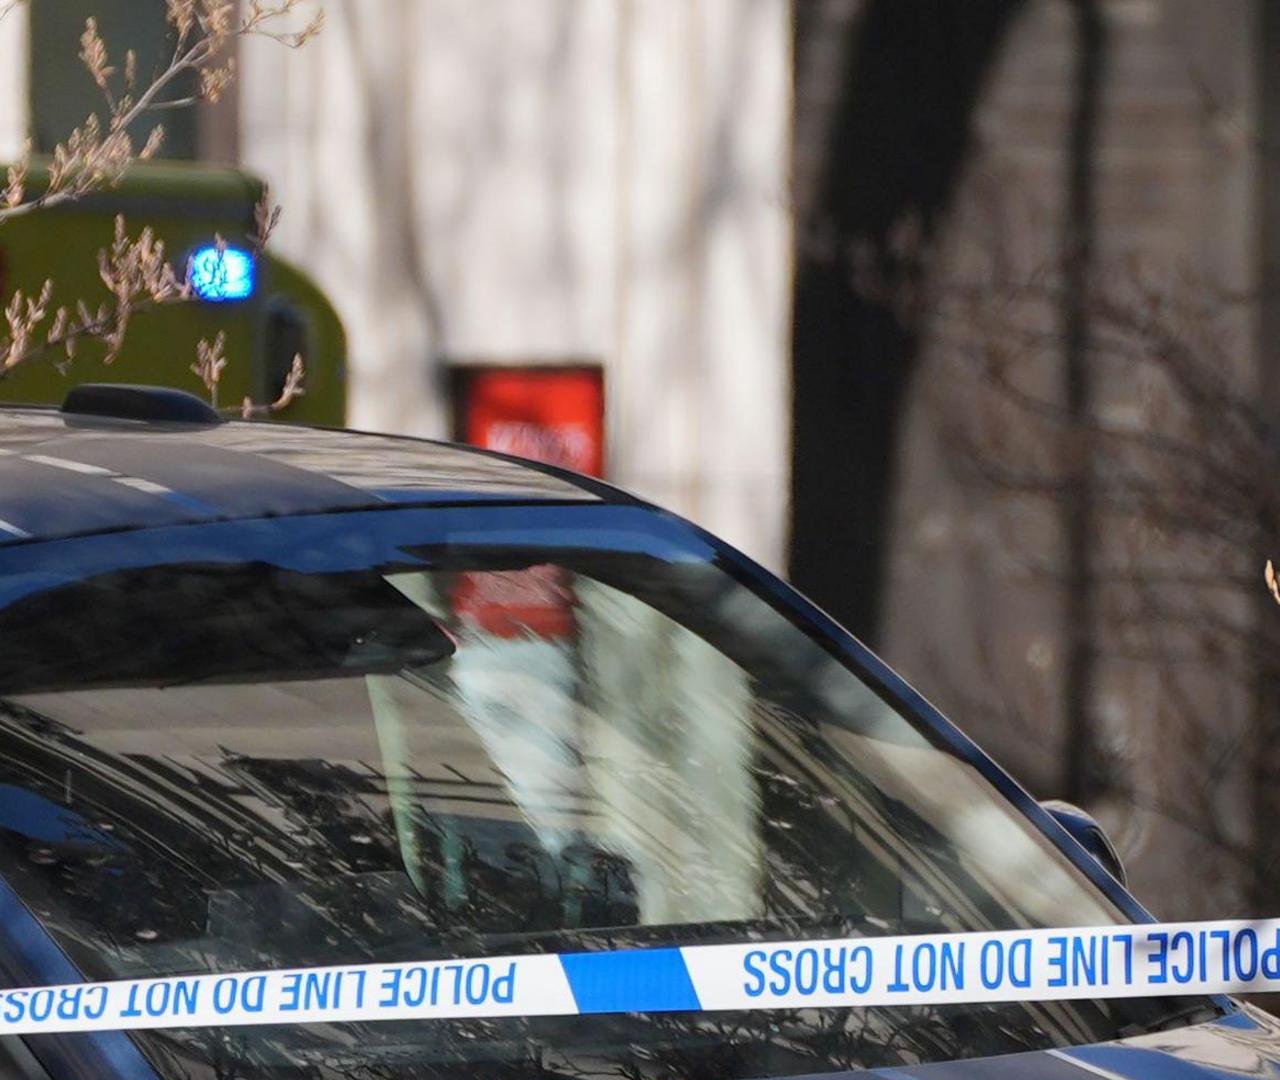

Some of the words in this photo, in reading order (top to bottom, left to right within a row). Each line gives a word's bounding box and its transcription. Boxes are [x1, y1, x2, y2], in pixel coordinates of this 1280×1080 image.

[743, 946, 873, 997] CROSS
[887, 942, 965, 993] NOT
[980, 939, 1032, 990] DO
[1047, 934, 1133, 987] LINE
[120, 980, 200, 1017] NOT
[213, 976, 267, 1014] DO
[279, 970, 367, 1012] LINE
[379, 962, 517, 1008] POLICE
